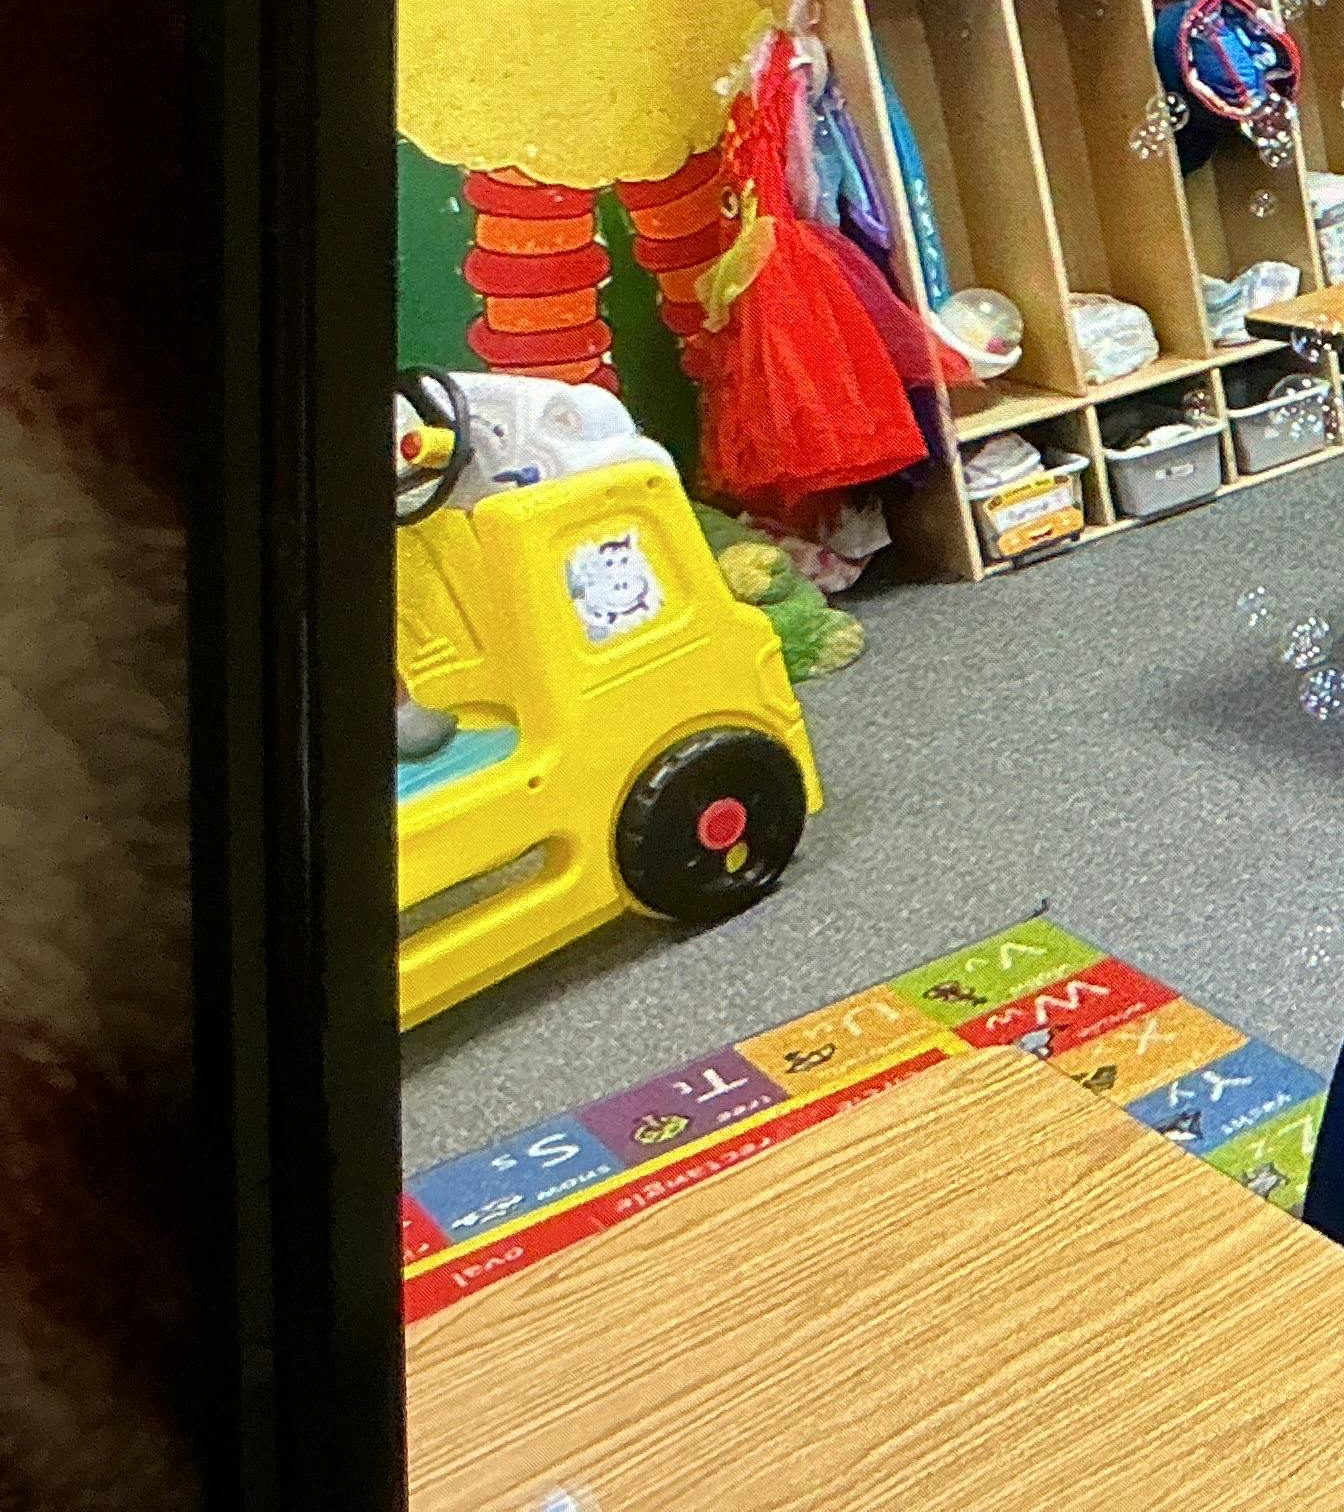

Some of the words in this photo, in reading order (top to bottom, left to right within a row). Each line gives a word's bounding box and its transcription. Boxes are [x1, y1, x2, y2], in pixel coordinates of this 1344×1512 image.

[537, 1164, 612, 1201] snow
[615, 1137, 771, 1214] rectangle
[452, 1245, 525, 1288] oval
